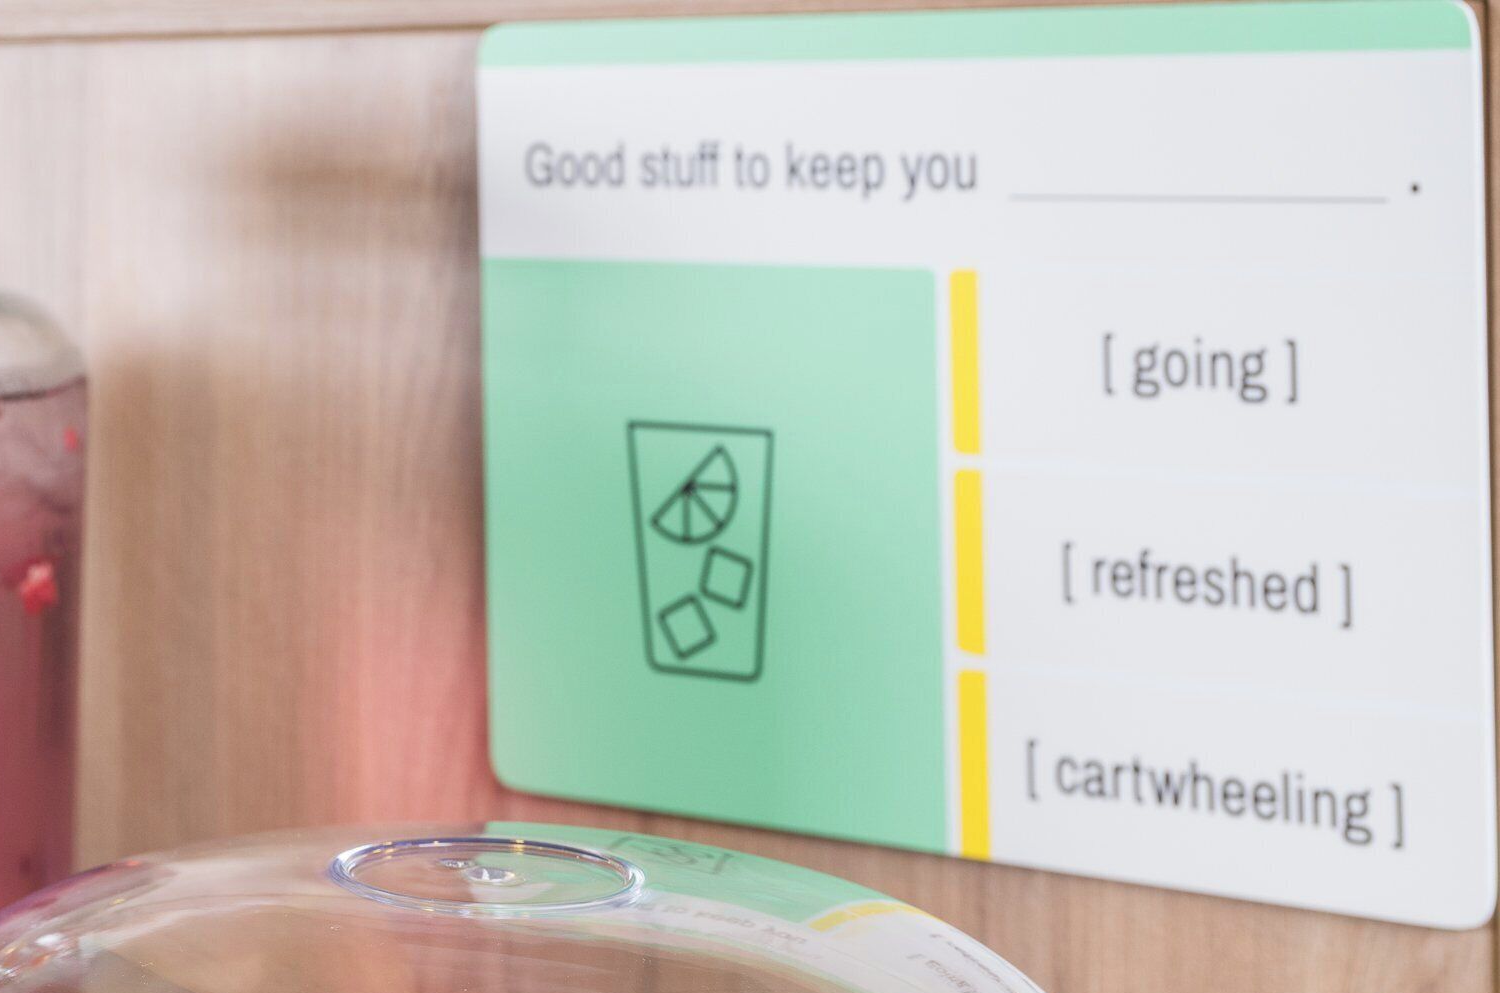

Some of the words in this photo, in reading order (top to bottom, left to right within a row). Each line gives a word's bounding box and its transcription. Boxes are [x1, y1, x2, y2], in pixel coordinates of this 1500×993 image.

[524, 141, 626, 189] Good
[638, 138, 722, 189] stuff
[733, 145, 772, 189] to
[785, 143, 887, 200] keep
[899, 151, 979, 202] you
